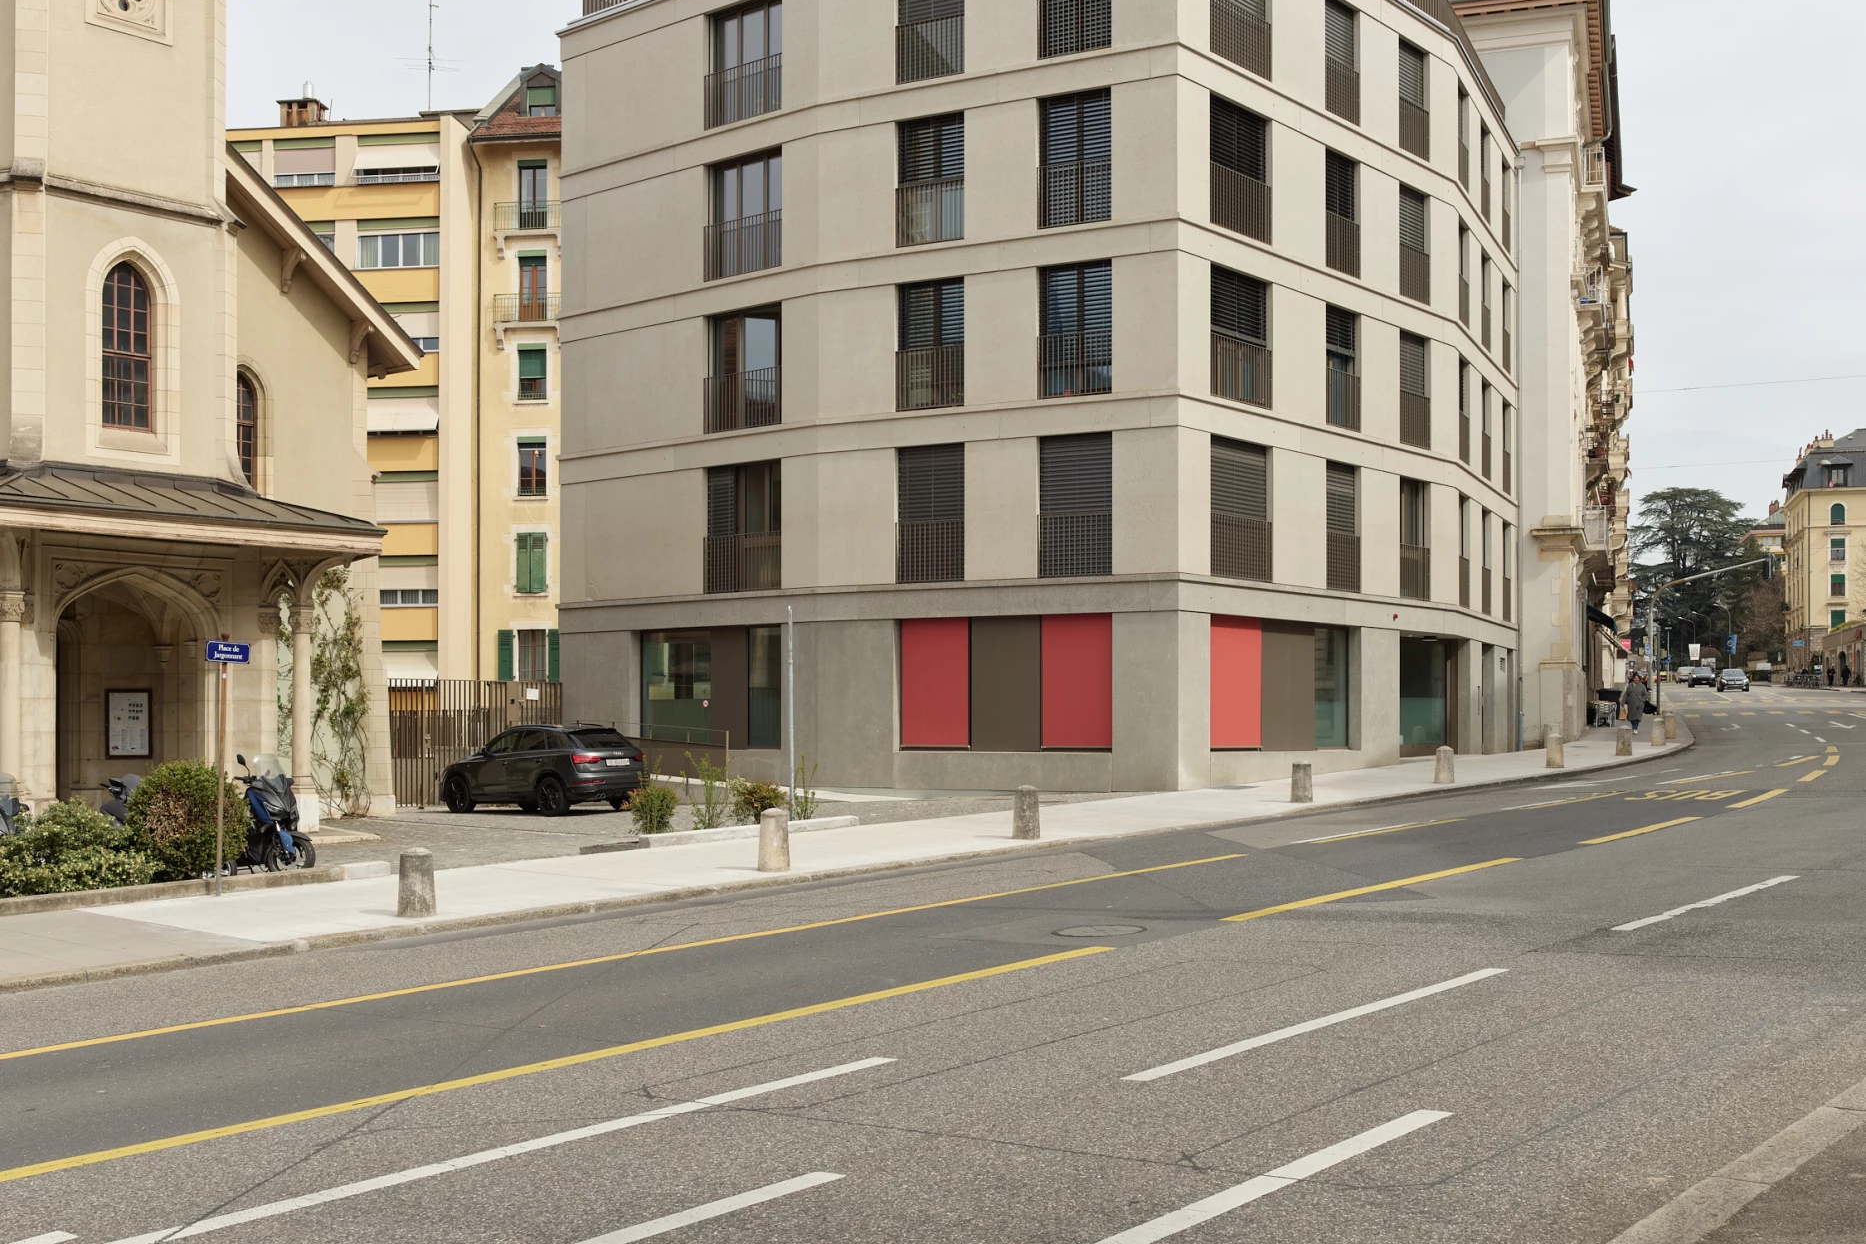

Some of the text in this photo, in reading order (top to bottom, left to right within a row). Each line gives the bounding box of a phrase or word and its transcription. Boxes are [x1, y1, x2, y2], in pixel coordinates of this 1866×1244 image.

[218, 644, 232, 652] Place
[213, 651, 243, 660] Jargonnant
[1624, 789, 1748, 801] BUS
